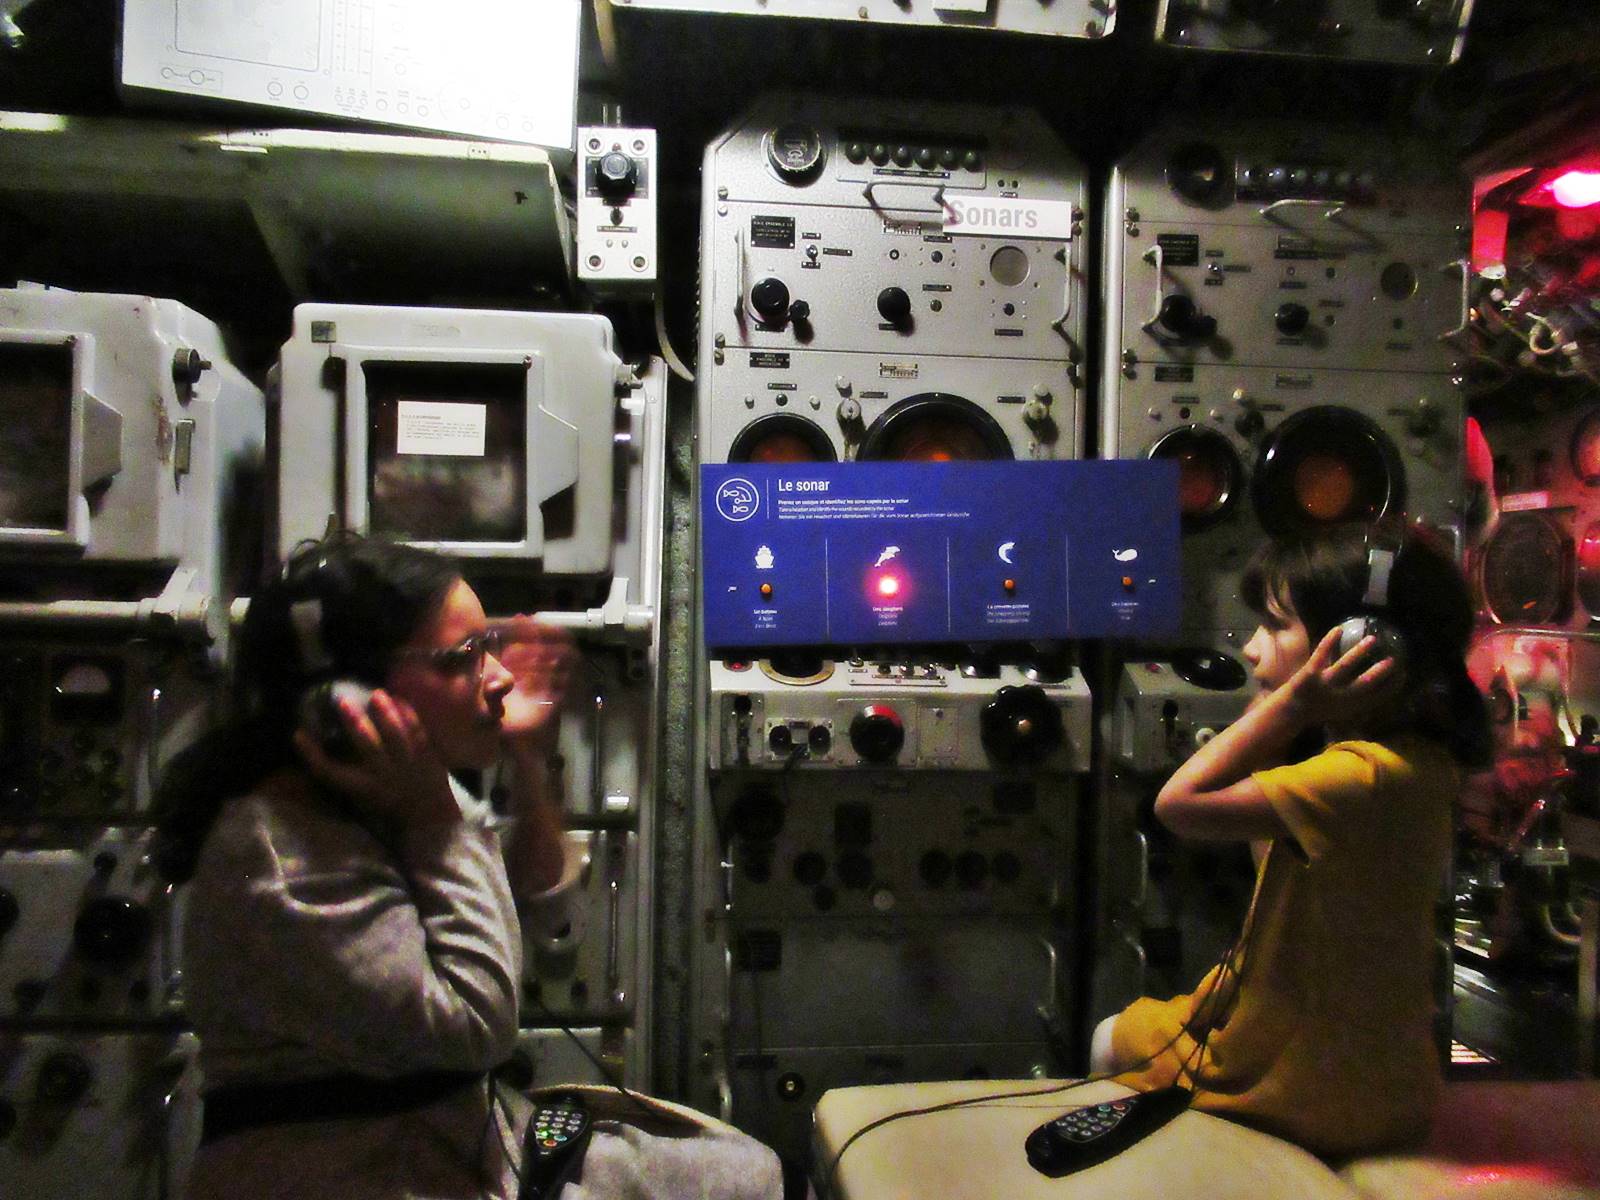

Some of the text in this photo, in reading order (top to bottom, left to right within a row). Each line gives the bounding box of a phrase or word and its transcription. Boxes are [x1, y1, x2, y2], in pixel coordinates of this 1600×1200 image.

[950, 199, 1038, 228] Sonars
[778, 479, 830, 491] Le sonar
